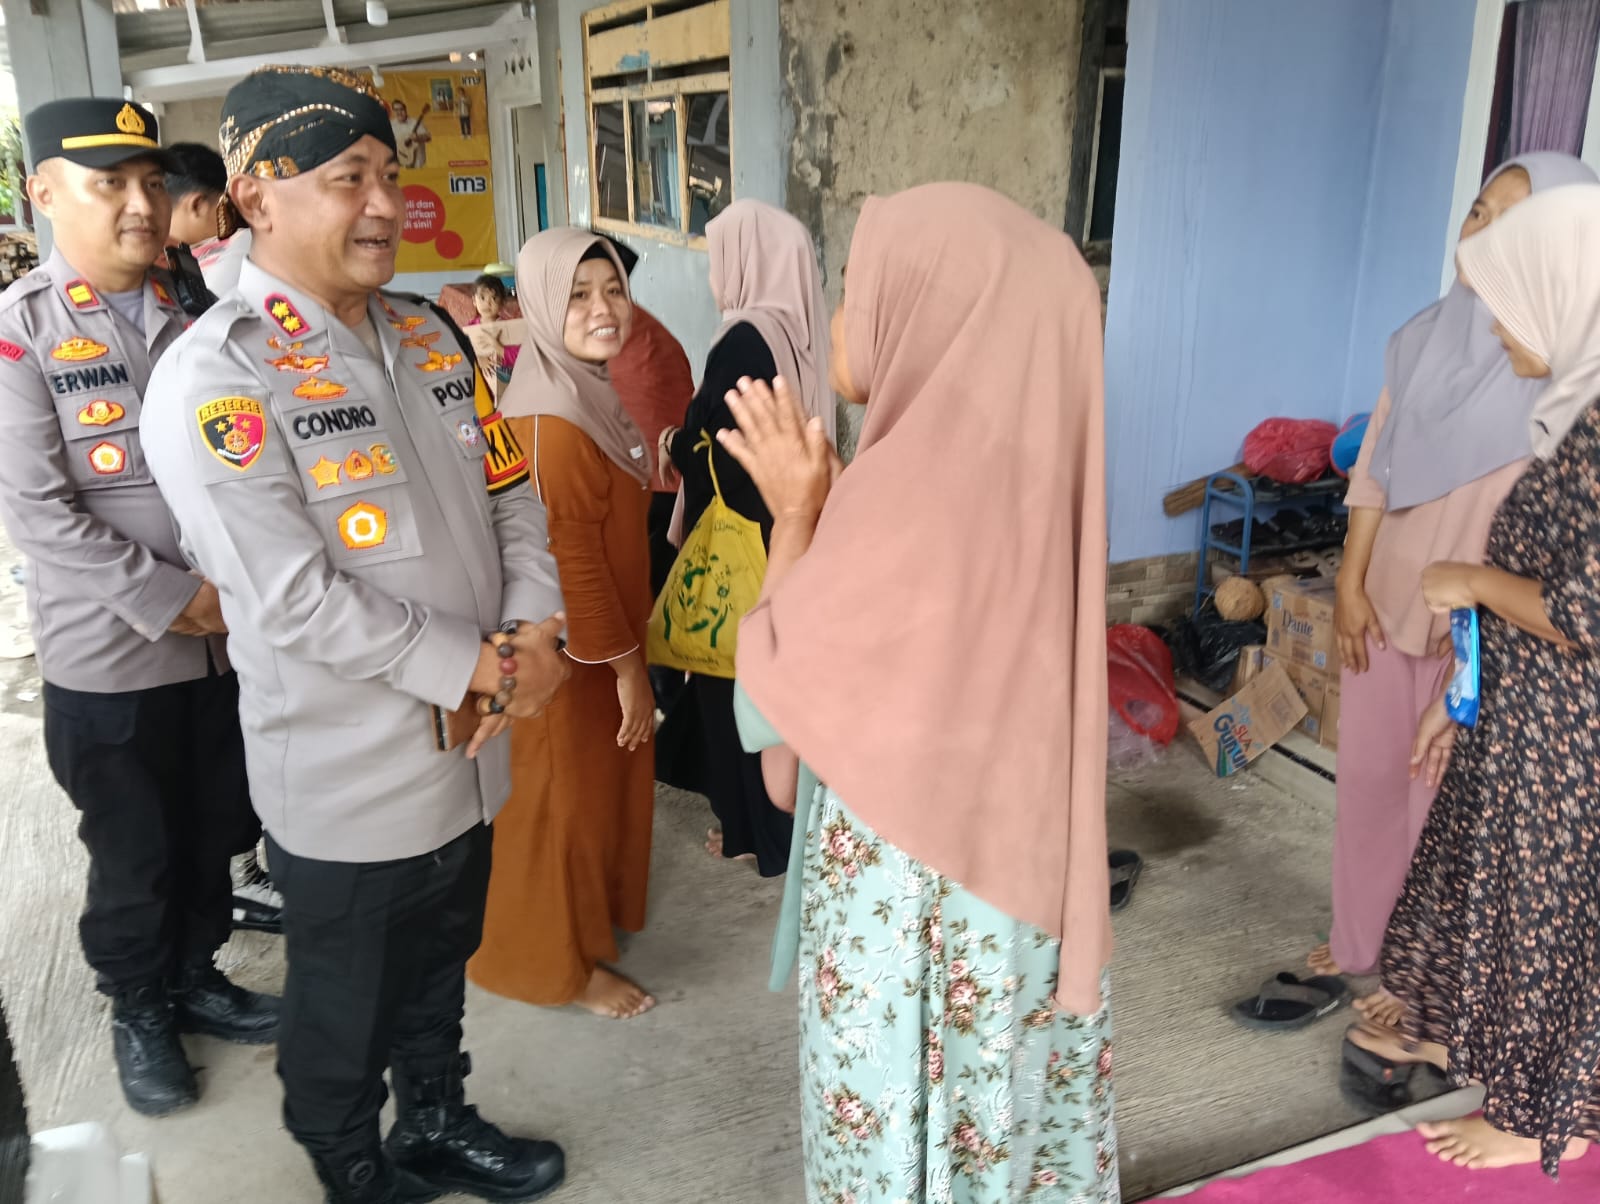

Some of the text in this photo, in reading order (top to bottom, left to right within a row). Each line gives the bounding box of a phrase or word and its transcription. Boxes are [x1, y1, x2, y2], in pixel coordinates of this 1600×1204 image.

[449, 171, 487, 193] im3
[406, 208, 437, 219] tifkan
[416, 199, 435, 209] dan
[51, 363, 129, 394] ERWAN
[199, 400, 261, 422] RESERSE
[292, 405, 377, 440] CONDRO
[1281, 607, 1314, 638] Dante
